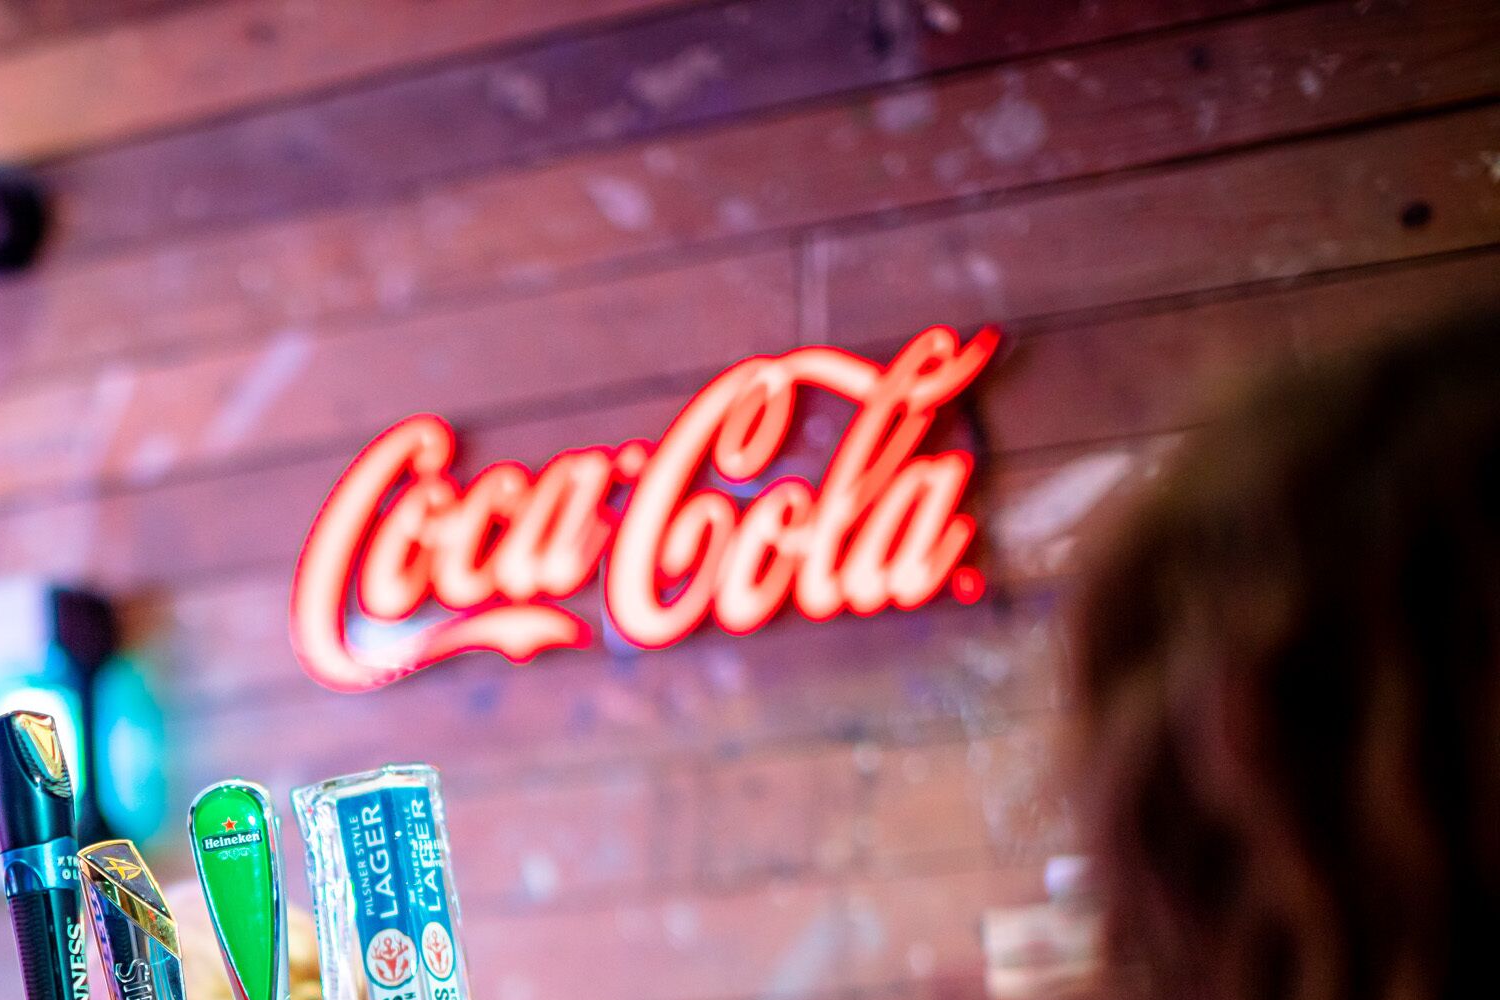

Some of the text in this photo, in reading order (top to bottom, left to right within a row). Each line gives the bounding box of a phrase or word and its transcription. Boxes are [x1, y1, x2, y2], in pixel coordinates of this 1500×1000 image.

[204, 832, 260, 850] Heineken
[349, 814, 376, 917] PILSNER STYLE
[361, 803, 400, 920] LAGER
